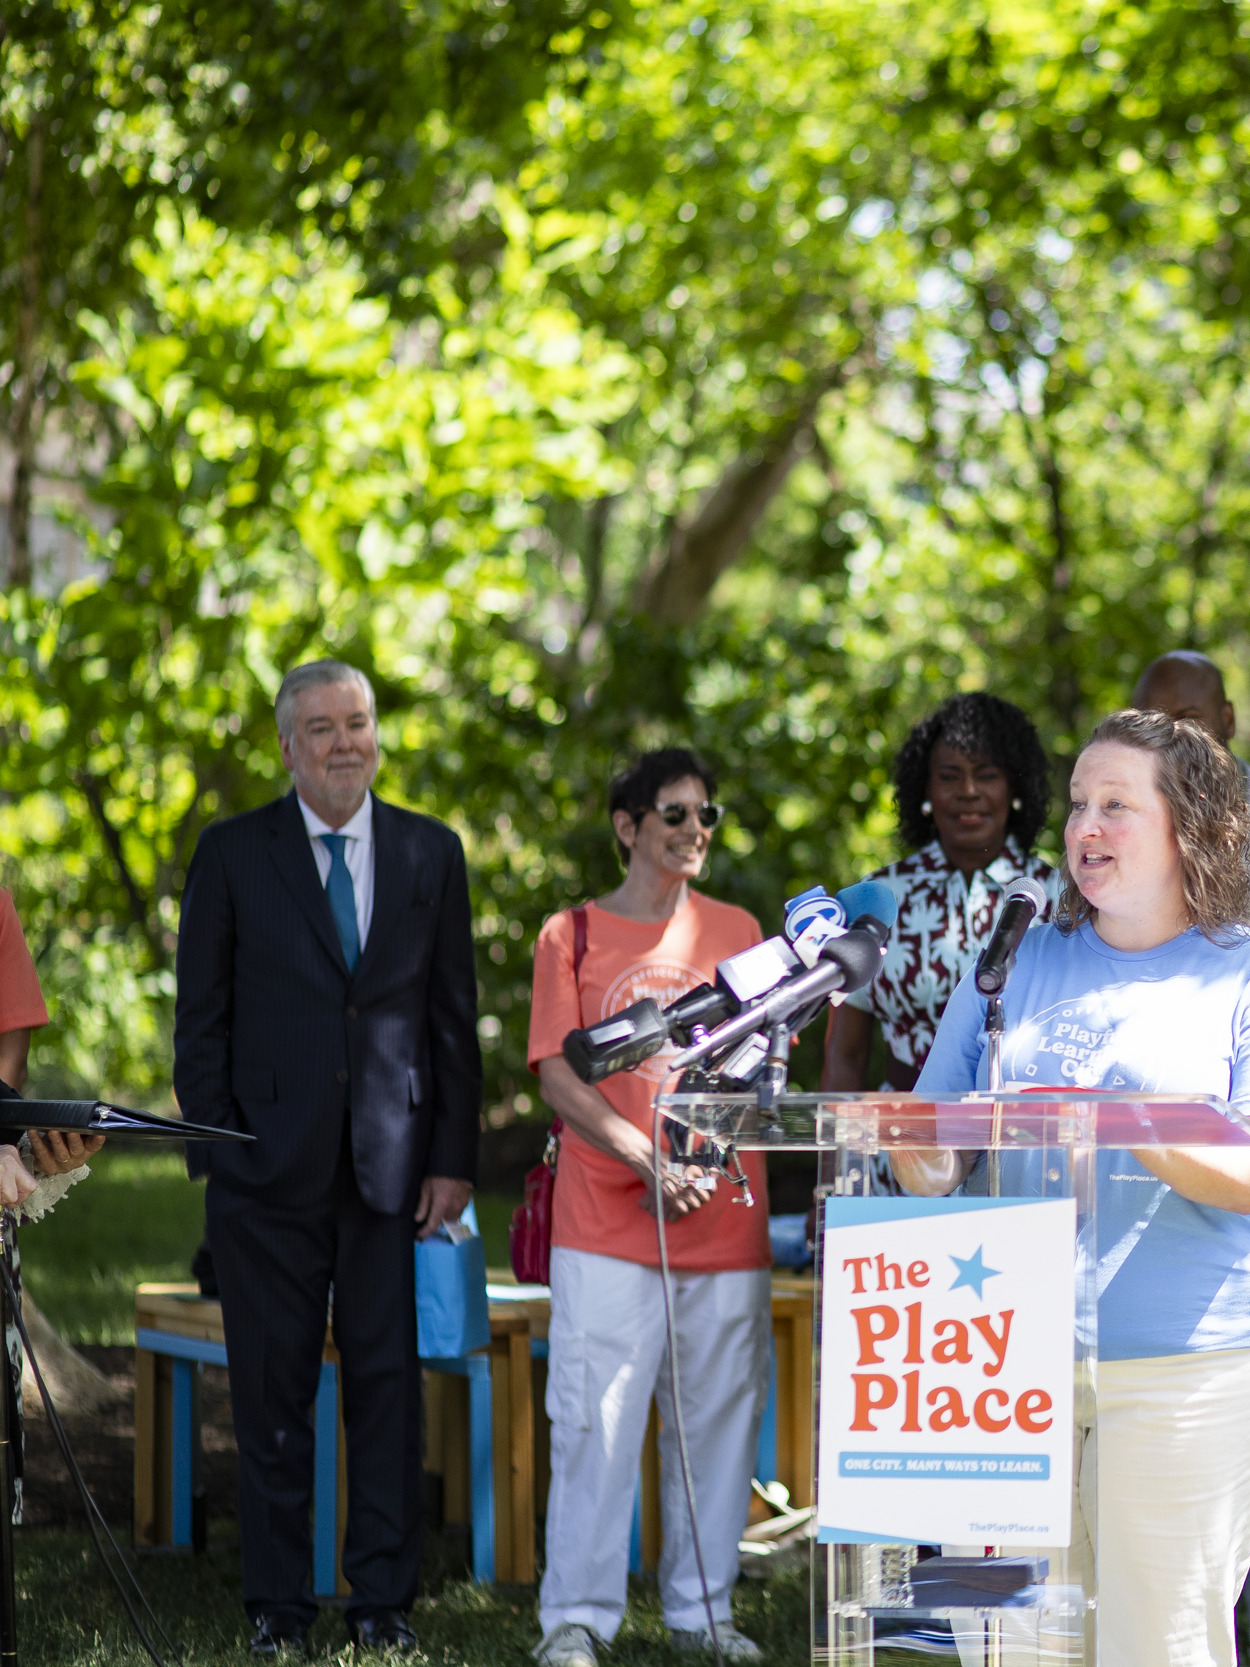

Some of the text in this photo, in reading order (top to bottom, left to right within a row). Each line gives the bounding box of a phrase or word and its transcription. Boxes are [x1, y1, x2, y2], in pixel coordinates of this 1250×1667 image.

[843, 1253, 930, 1294] The
[850, 1302, 1015, 1377] Play
[849, 1369, 1053, 1433] Place
[844, 1458, 1044, 1473] ONE CITY. MANY WAYS TO LEARN.
